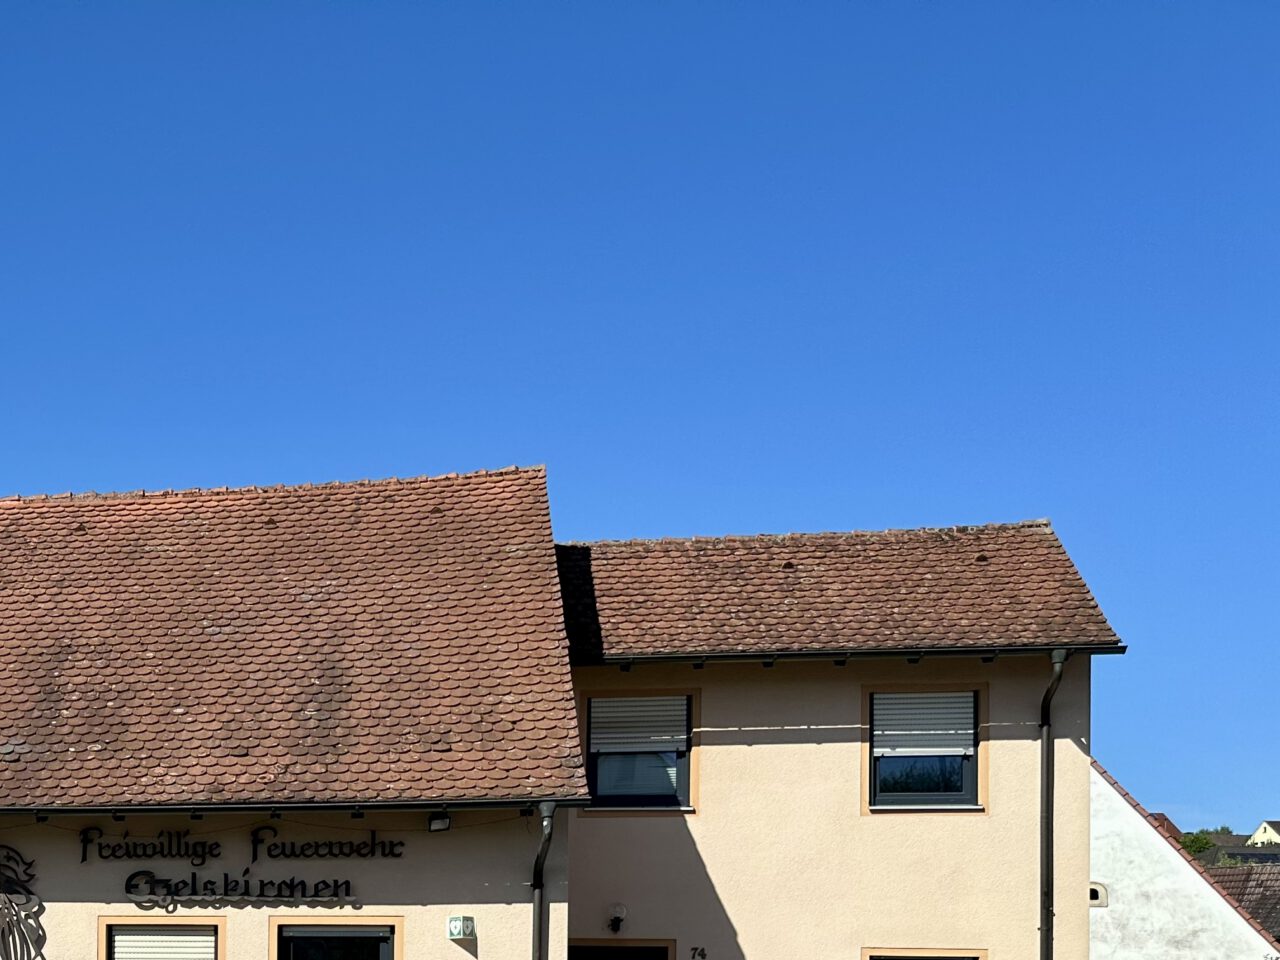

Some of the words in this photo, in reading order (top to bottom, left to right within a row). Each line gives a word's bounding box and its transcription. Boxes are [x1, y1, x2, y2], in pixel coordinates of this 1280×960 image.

[79, 826, 222, 866] Freiwillige
[250, 825, 405, 864] Feuerwehr
[690, 947, 707, 960] 74
